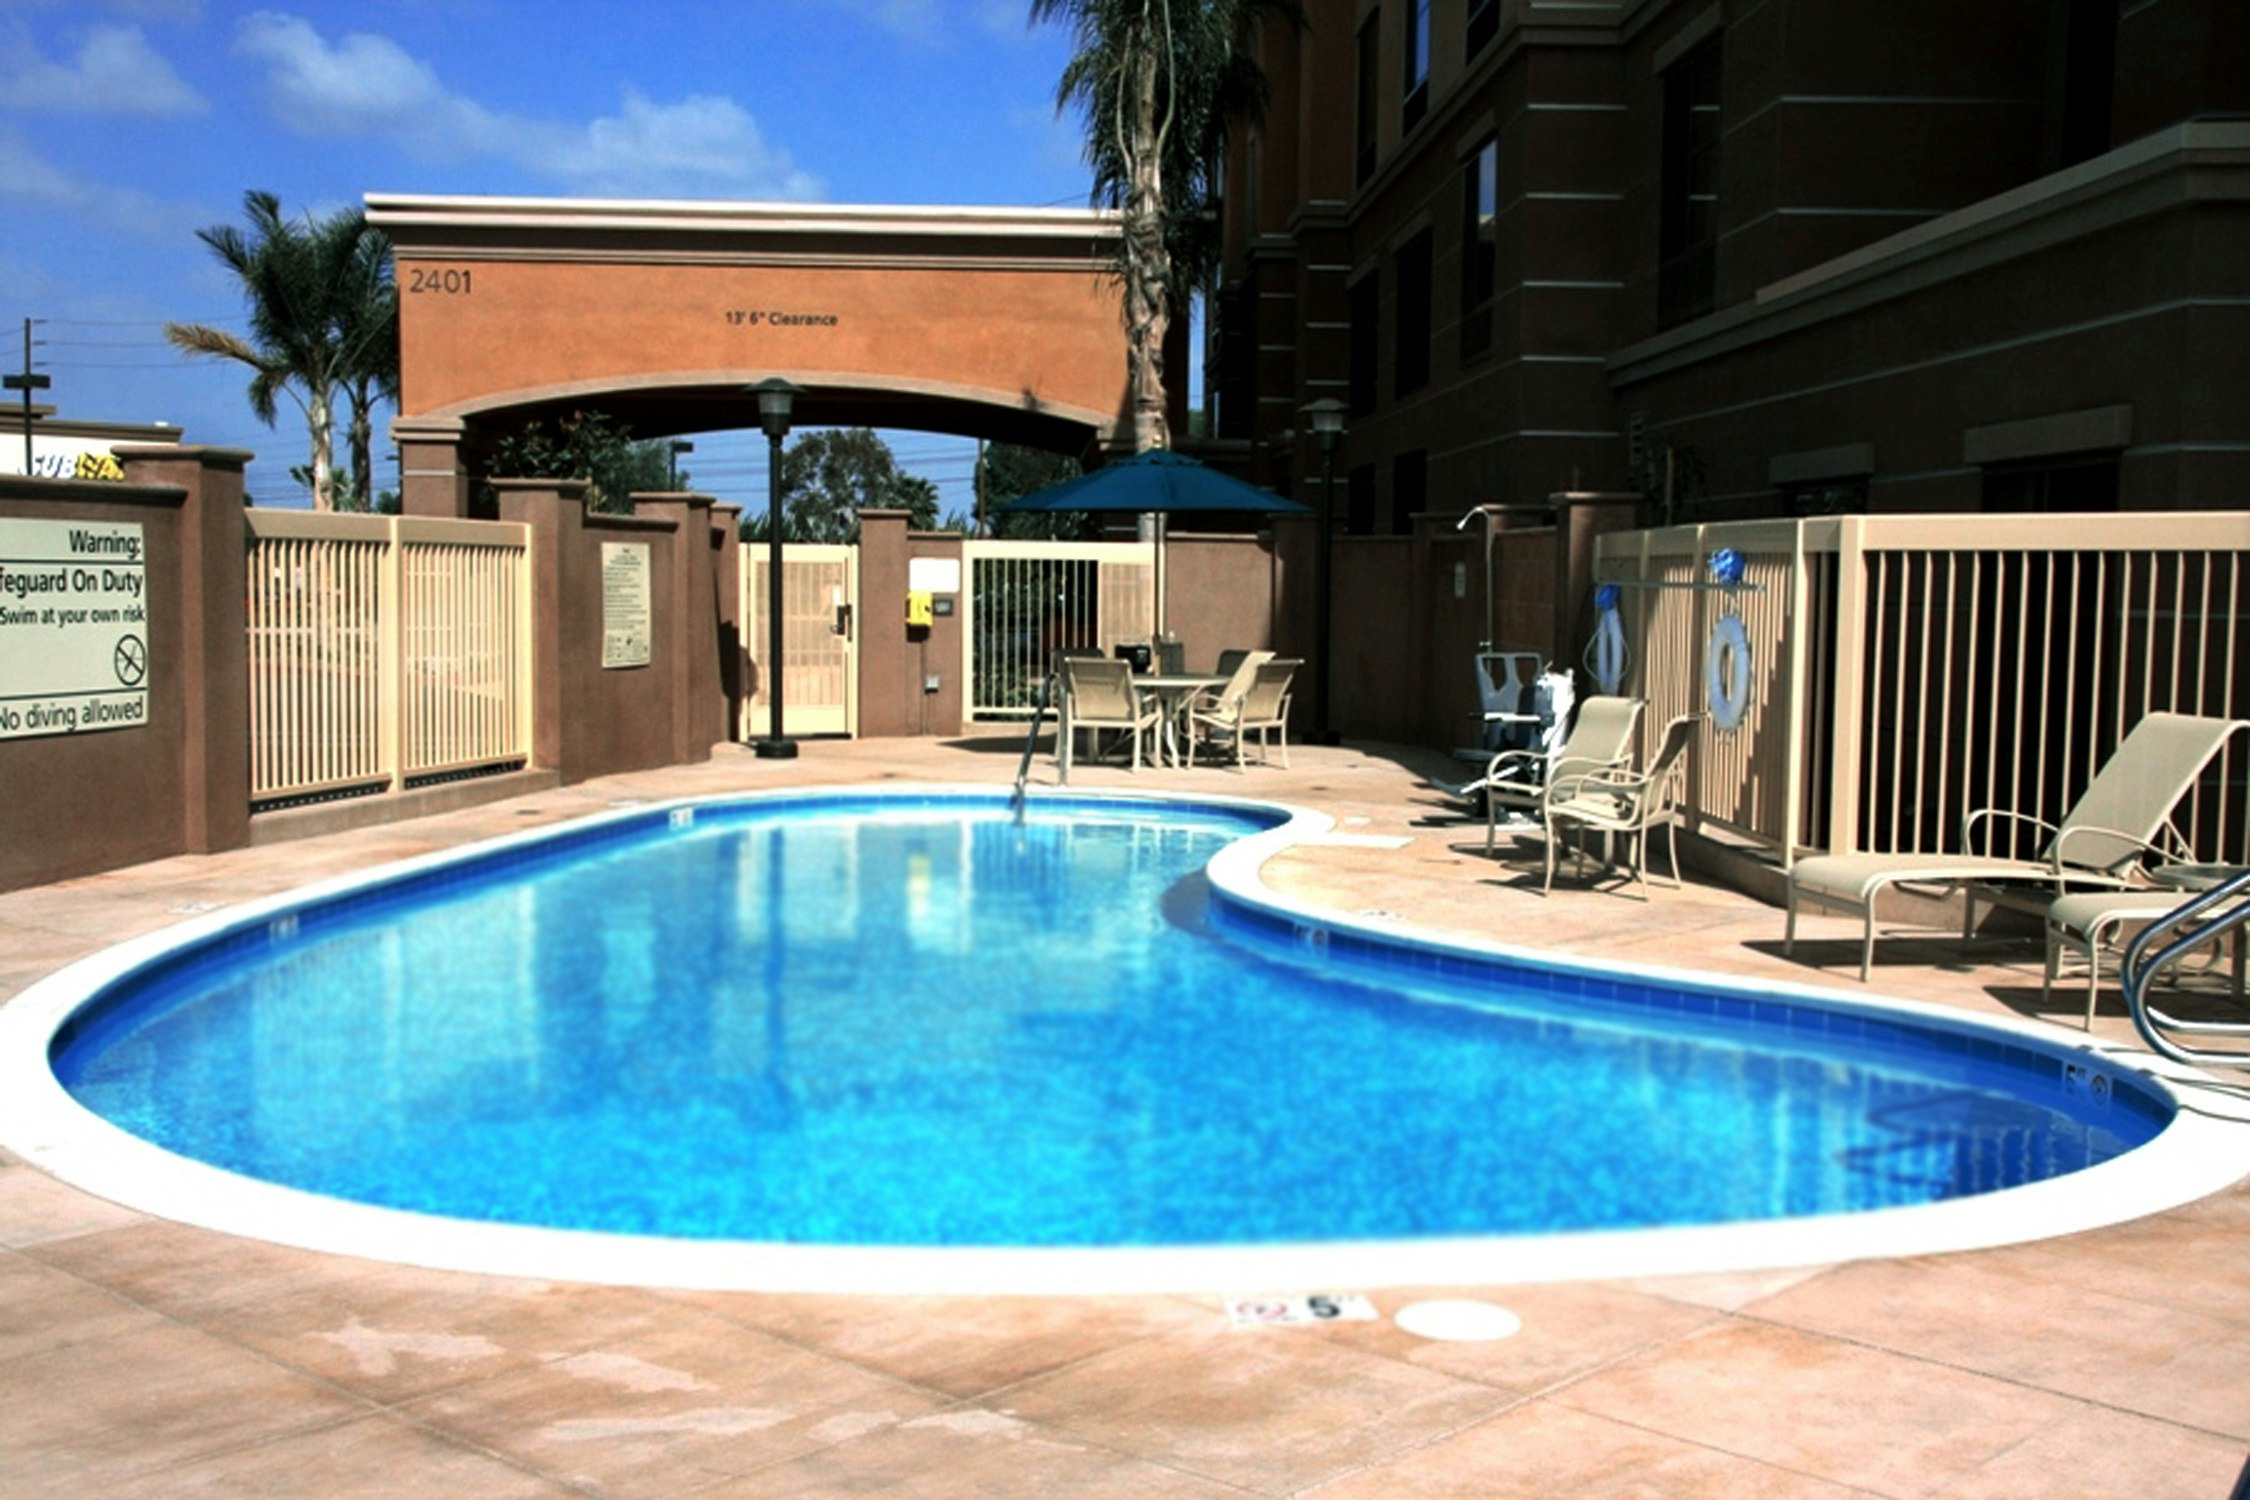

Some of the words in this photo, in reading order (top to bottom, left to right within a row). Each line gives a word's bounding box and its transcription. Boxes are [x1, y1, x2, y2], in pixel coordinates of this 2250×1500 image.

[410, 269, 471, 293] 2401
[768, 311, 839, 326] Clearance
[69, 529, 141, 560] Warning:
[72, 568, 98, 592] On
[102, 568, 143, 598] Duty
[0, 606, 38, 625] Swim
[41, 607, 55, 624] at
[58, 609, 87, 628] your
[90, 608, 120, 623] own
[122, 603, 144, 622] risk
[26, 702, 77, 732] diving
[82, 695, 143, 723] allowed
[1307, 1295, 1341, 1319] 5
